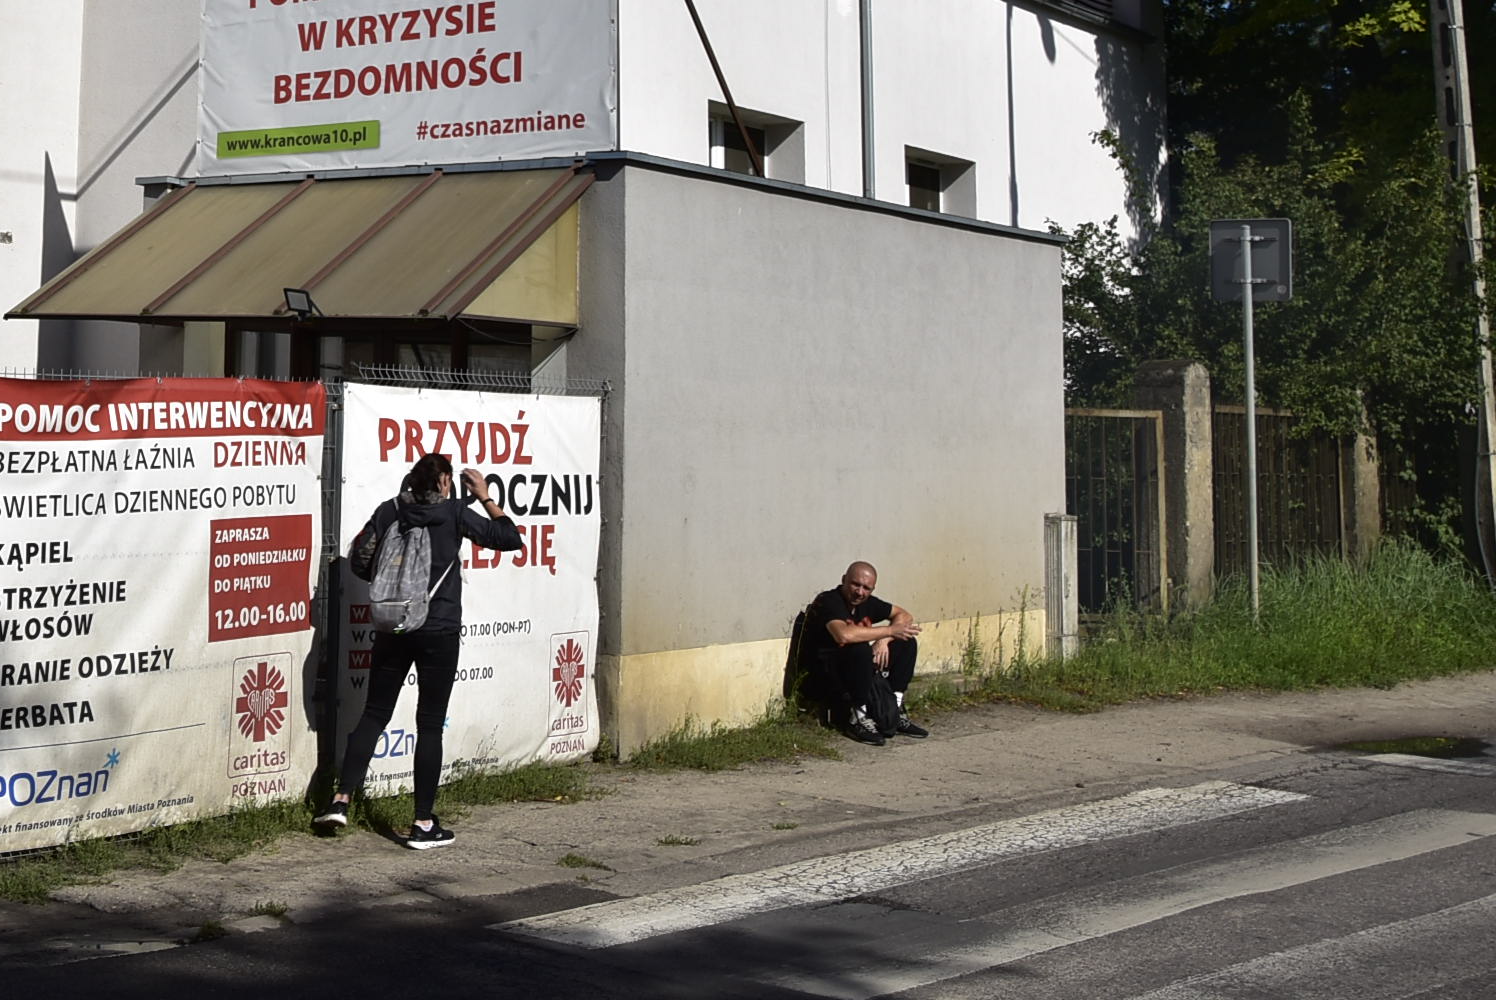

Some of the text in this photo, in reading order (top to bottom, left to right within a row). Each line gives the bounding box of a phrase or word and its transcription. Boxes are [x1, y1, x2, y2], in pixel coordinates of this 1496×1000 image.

[297, 1, 497, 52] W KRYZYSIE
[273, 48, 523, 105] BEZDOMNOŚCI
[226, 127, 367, 152] www.krancowa10.pl
[416, 111, 586, 141] #czasnazmiane
[108, 400, 313, 432] INTERWENCYJNA
[378, 411, 533, 466] PRZYJDŹ
[122, 442, 195, 471] ŁAŹNIA
[213, 441, 306, 469] DZIENNA
[114, 486, 227, 515] DZIENNEGO
[232, 484, 297, 508] POBYTU
[215, 526, 270, 543] ZAPRASZA
[214, 547, 307, 568] OD PONIEDZIAŁKU
[512, 524, 557, 576] SIĘ
[214, 574, 272, 594] DO PIĄTKU
[215, 600, 306, 631] 12.00-16.00
[469, 623, 491, 637] 17.00
[492, 618, 532, 638] (PON-PT)
[78, 648, 175, 679] ODZIEŻY
[469, 666, 494, 681] 07.00
[551, 712, 584, 731] caritas
[233, 749, 286, 771] caritas
[550, 735, 585, 755] POZNAŃ
[231, 774, 286, 798] POZNAŃ
[15, 816, 74, 833] finansowany
[75, 813, 84, 823] ze
[85, 807, 126, 821] środków
[127, 801, 155, 815] Miasta
[156, 794, 194, 809] Poznania
